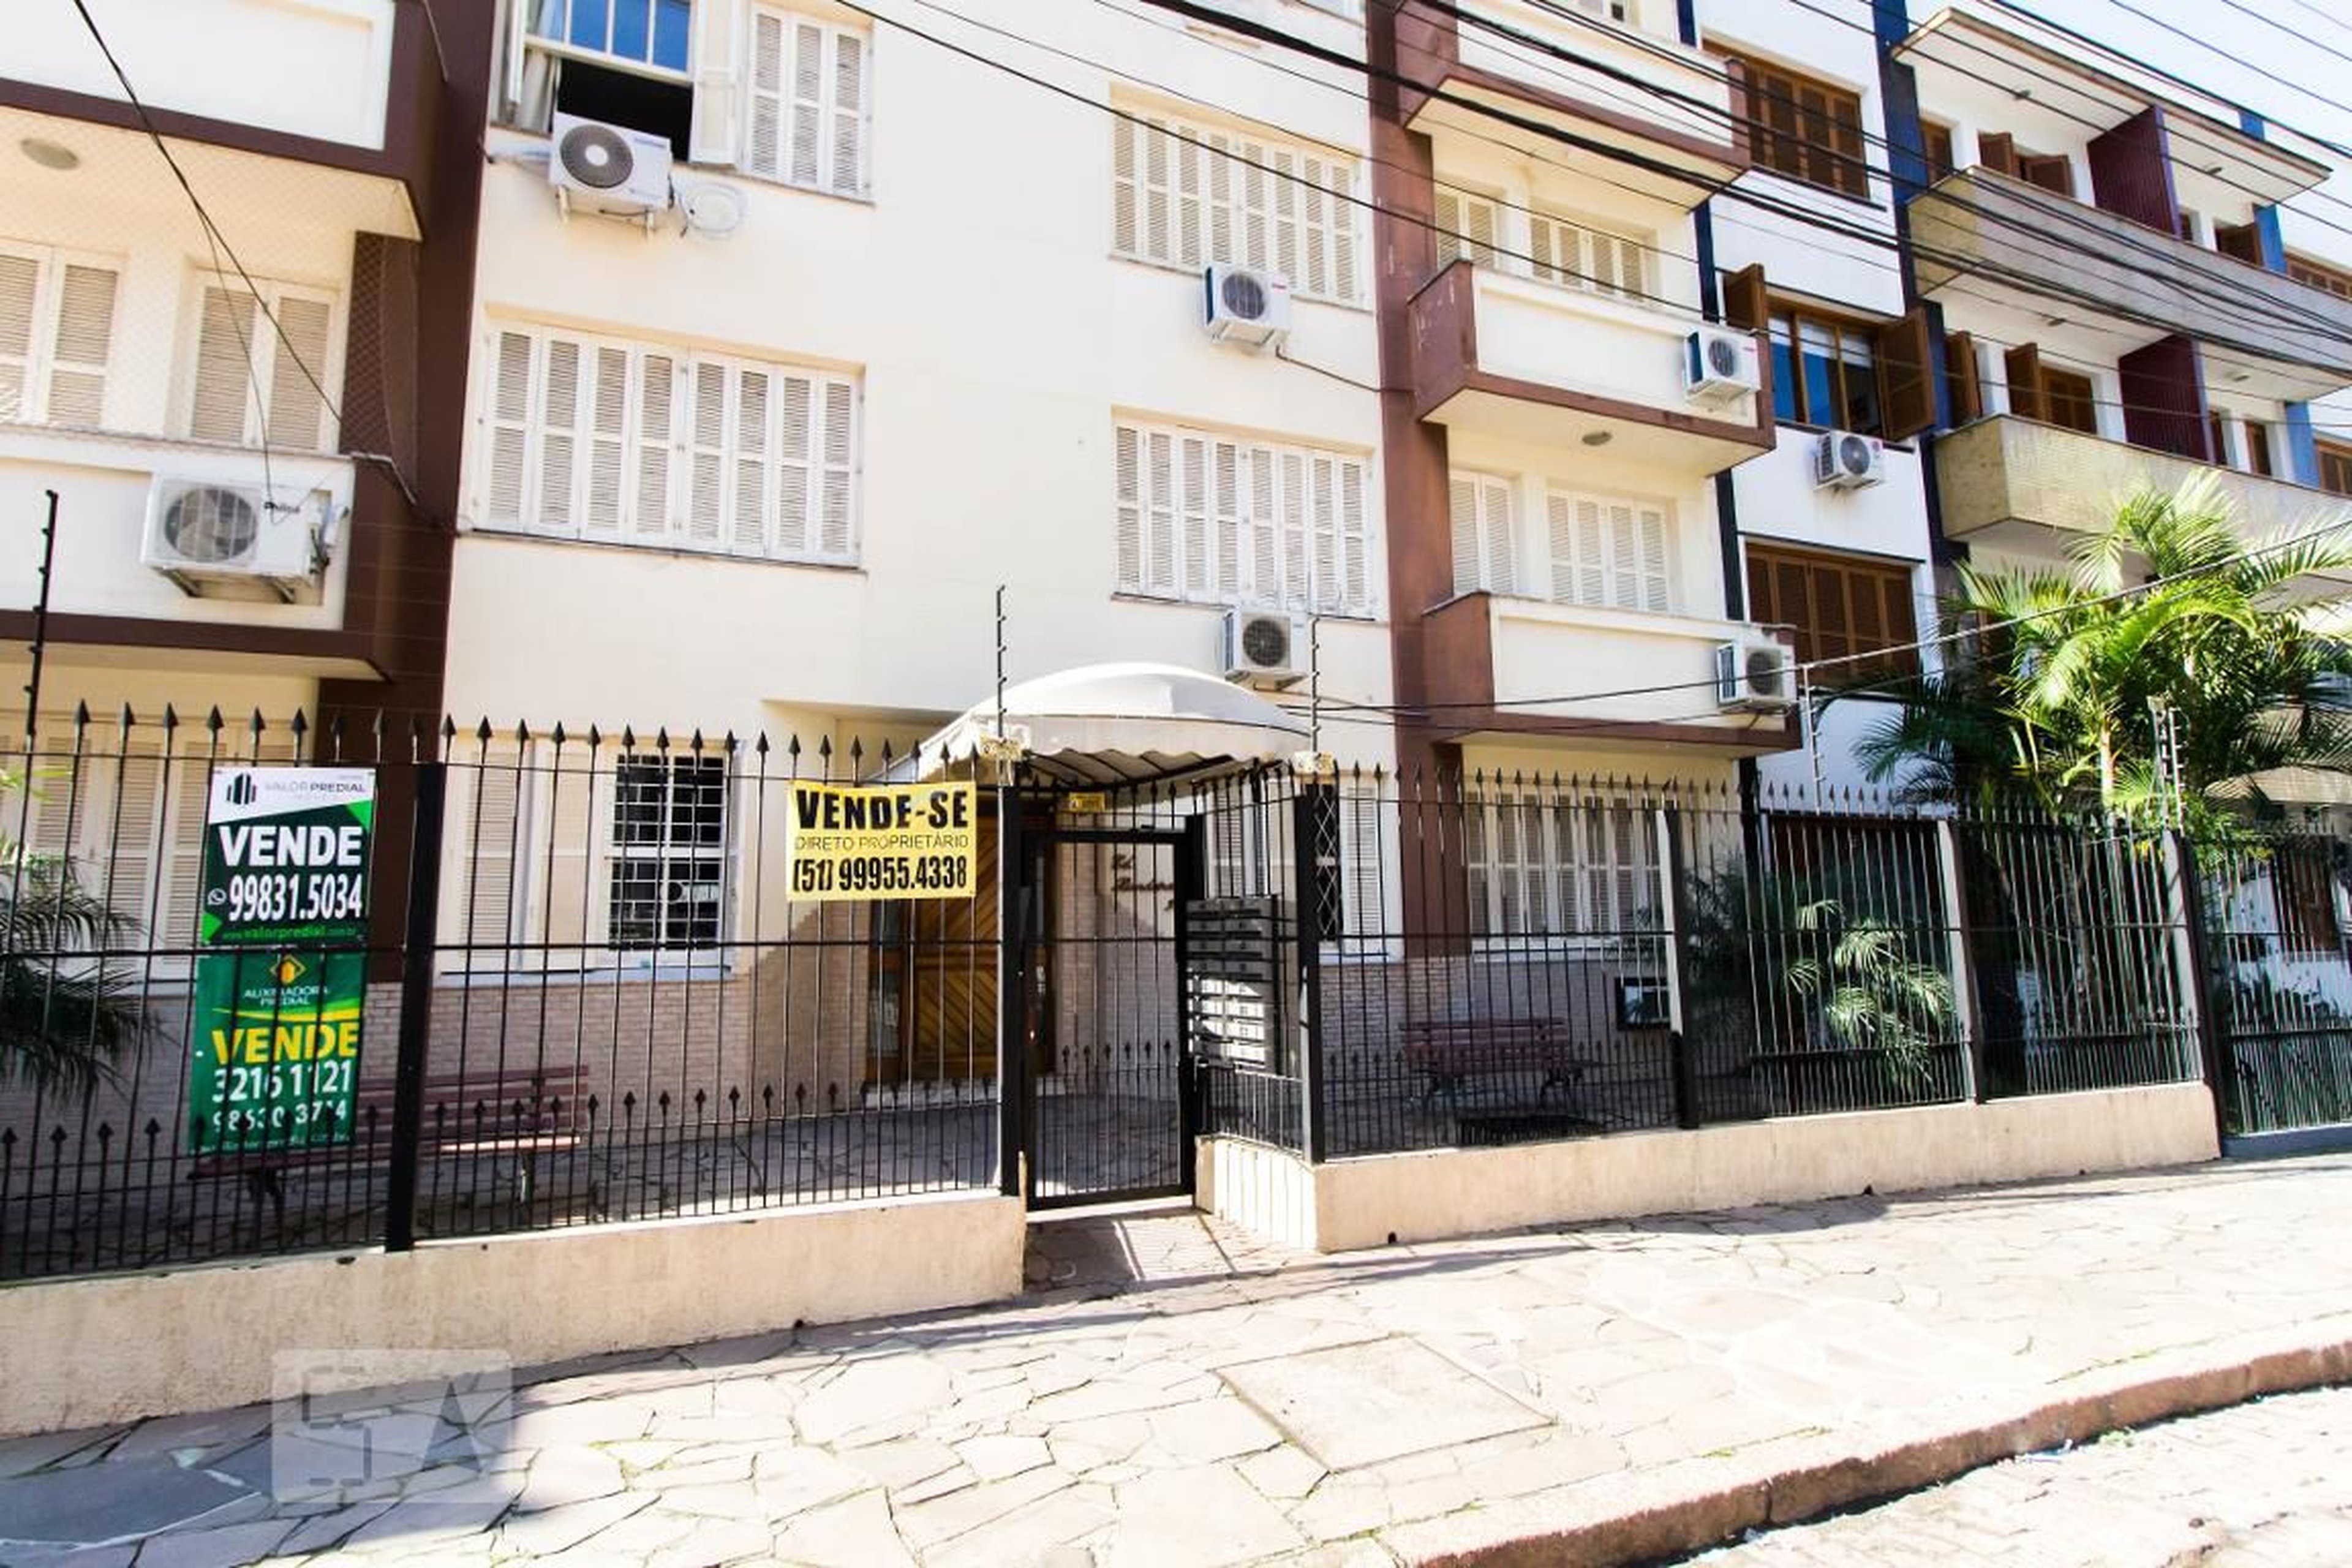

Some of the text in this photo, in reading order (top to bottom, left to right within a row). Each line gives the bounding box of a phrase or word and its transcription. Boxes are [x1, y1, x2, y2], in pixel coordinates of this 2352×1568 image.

[265, 781, 366, 793] VALOR PREDIAL
[796, 790, 968, 829] VENDE-SE
[219, 826, 363, 866] VENDE
[794, 836, 854, 850] DIRETO
[793, 856, 967, 891] (51) 99955.4338
[229, 873, 363, 921] 99831.5034
[212, 1022, 359, 1065] VENDE
